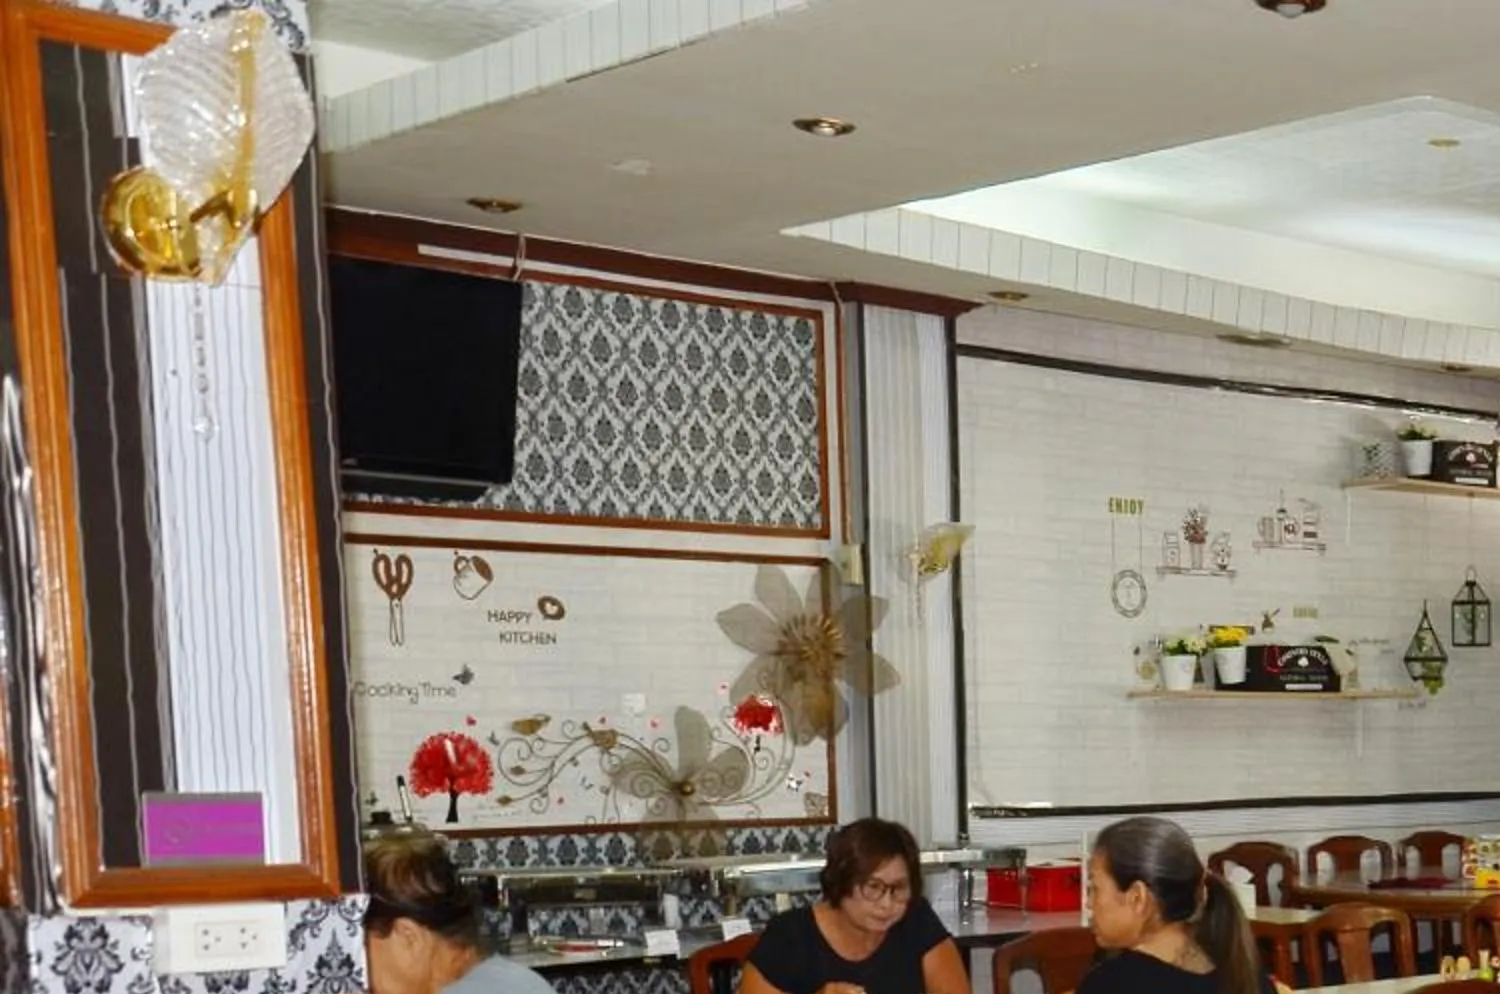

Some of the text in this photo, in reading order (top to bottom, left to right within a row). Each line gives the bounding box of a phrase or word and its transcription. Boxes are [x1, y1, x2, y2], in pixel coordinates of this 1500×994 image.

[488, 610, 533, 624] HAPPY
[499, 631, 557, 644] KITCHEN
[419, 682, 456, 697] Time
